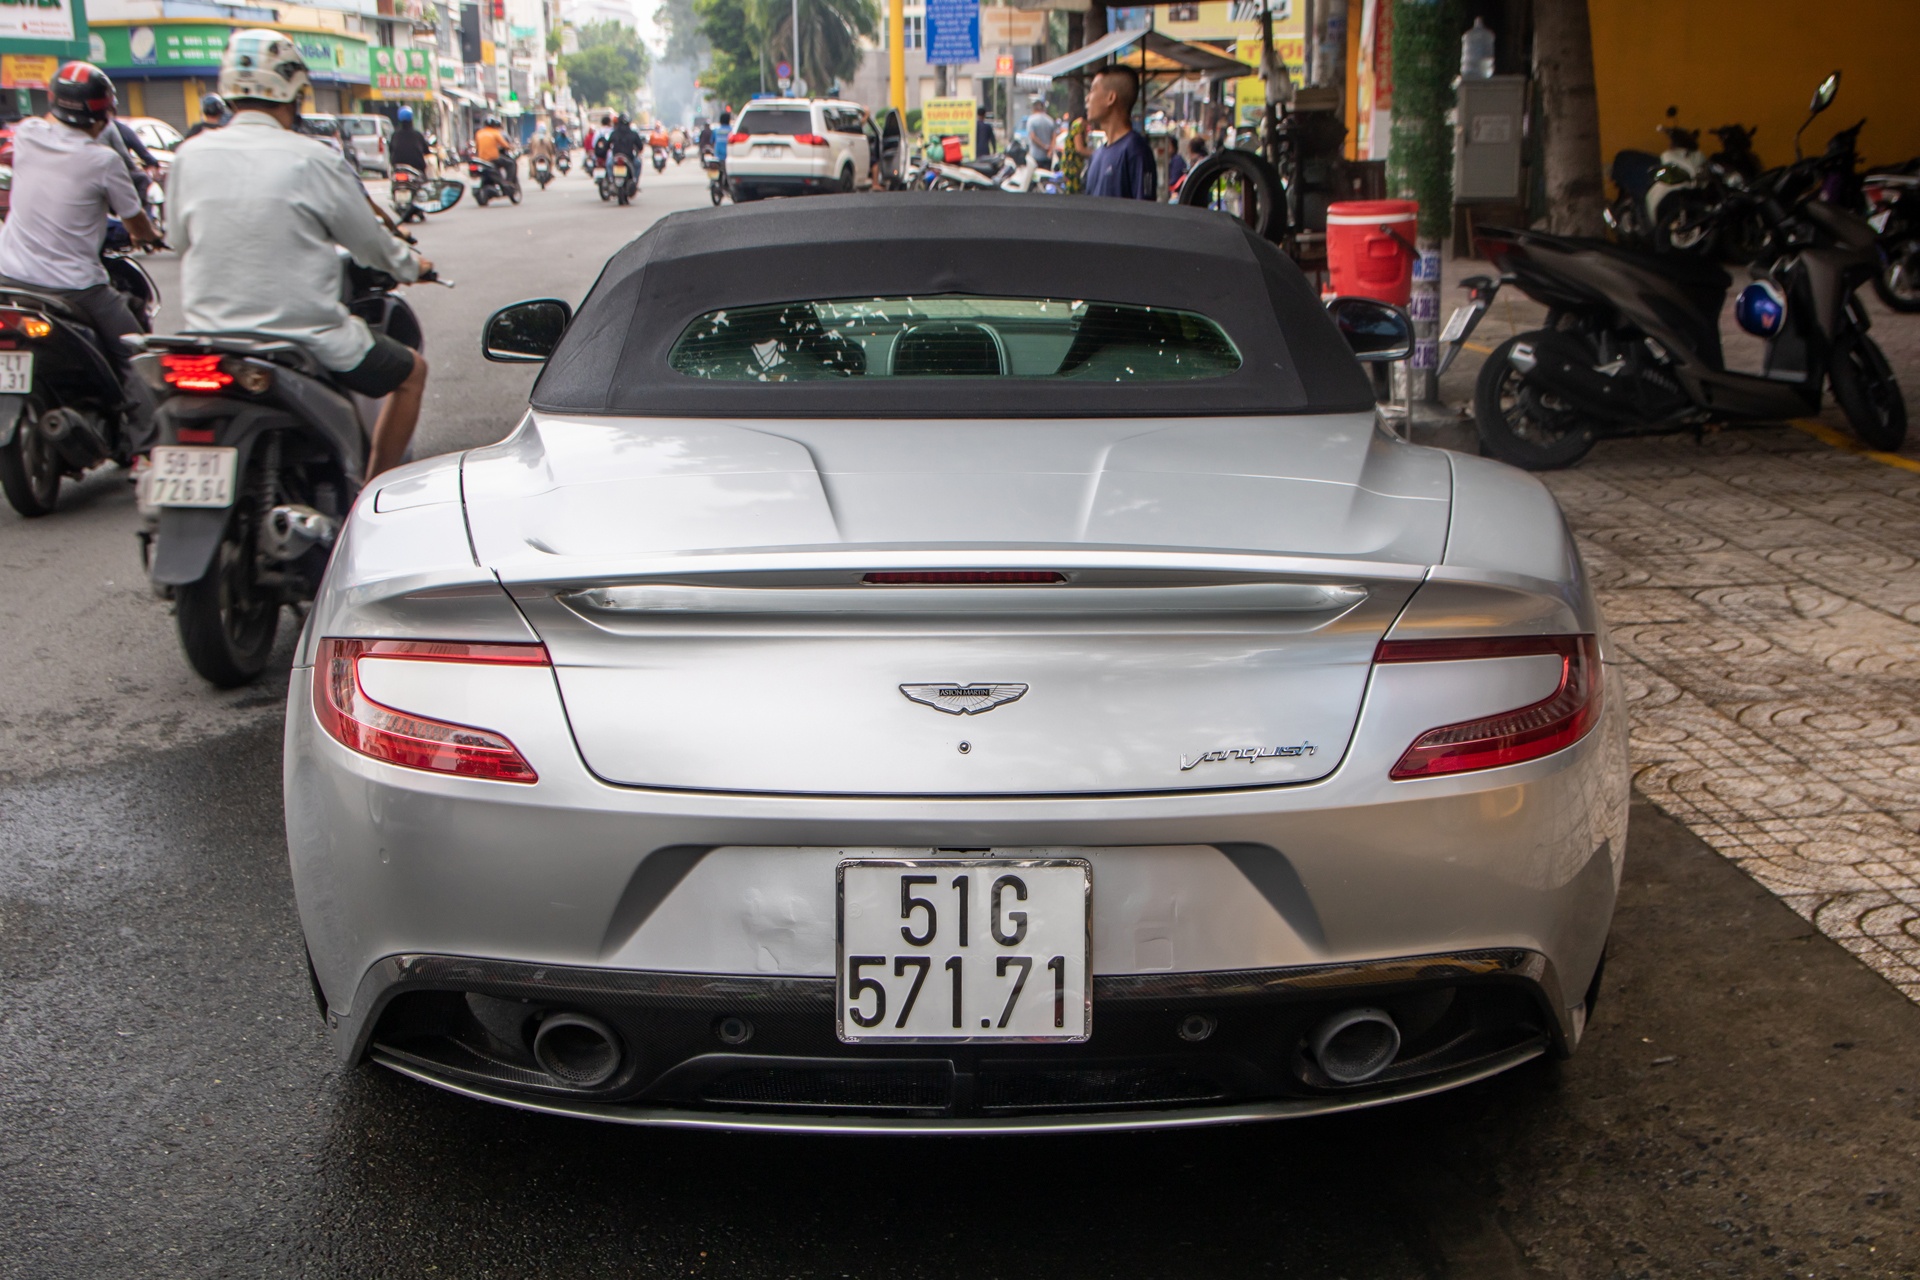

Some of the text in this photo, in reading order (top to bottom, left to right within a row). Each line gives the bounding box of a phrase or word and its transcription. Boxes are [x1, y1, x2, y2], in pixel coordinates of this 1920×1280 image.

[0, 374, 25, 389] .31
[154, 478, 226, 501] 726.64
[1180, 740, 1319, 771] Vanquish
[901, 875, 1028, 947] 51G
[849, 956, 1065, 1028] 571.71
